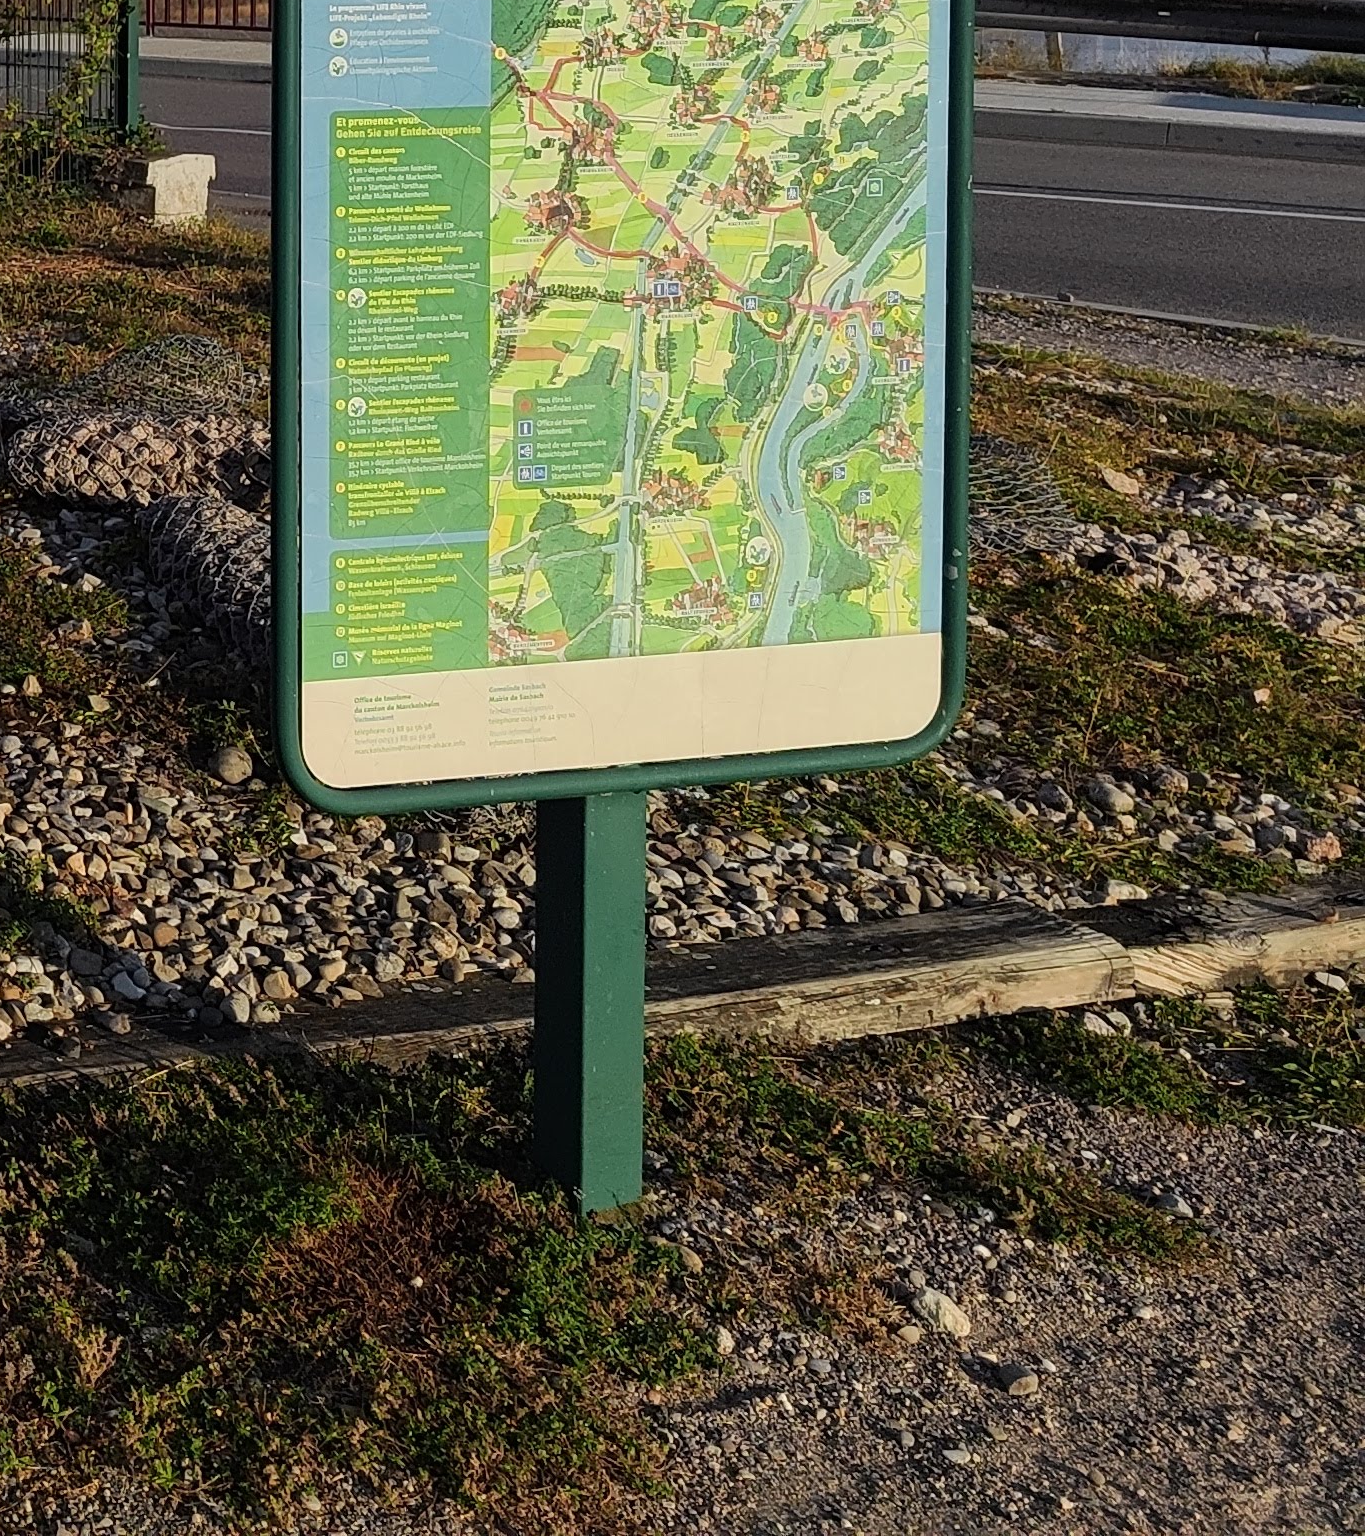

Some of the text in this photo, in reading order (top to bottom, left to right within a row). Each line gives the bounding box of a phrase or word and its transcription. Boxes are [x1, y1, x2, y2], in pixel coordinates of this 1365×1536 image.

[336, 117, 420, 128] Et promenez-vous
[336, 126, 481, 139] Gehen Sie auf Entdeckungsreise
